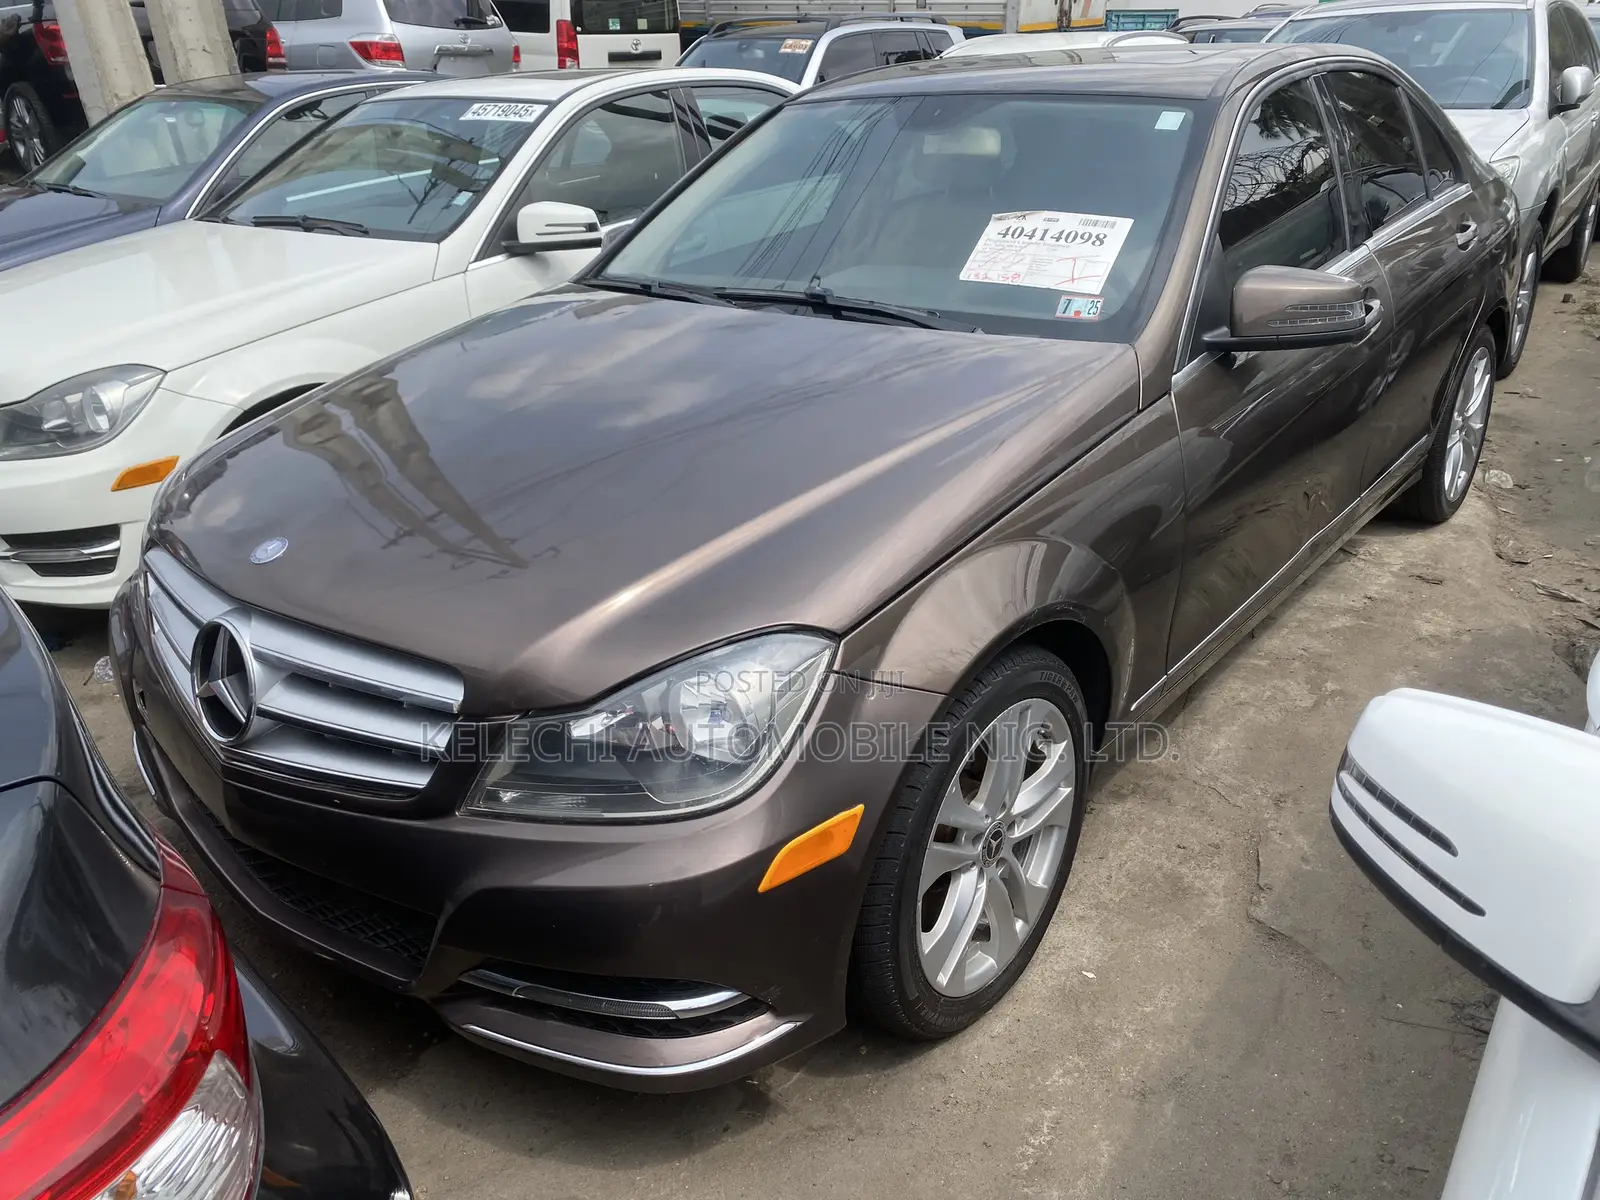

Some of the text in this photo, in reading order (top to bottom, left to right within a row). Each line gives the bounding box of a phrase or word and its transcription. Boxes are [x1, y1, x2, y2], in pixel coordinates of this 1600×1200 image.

[997, 225, 1108, 247] 40414098
[1062, 298, 1101, 316] 7 25
[1040, 671, 1063, 687] TIGER
